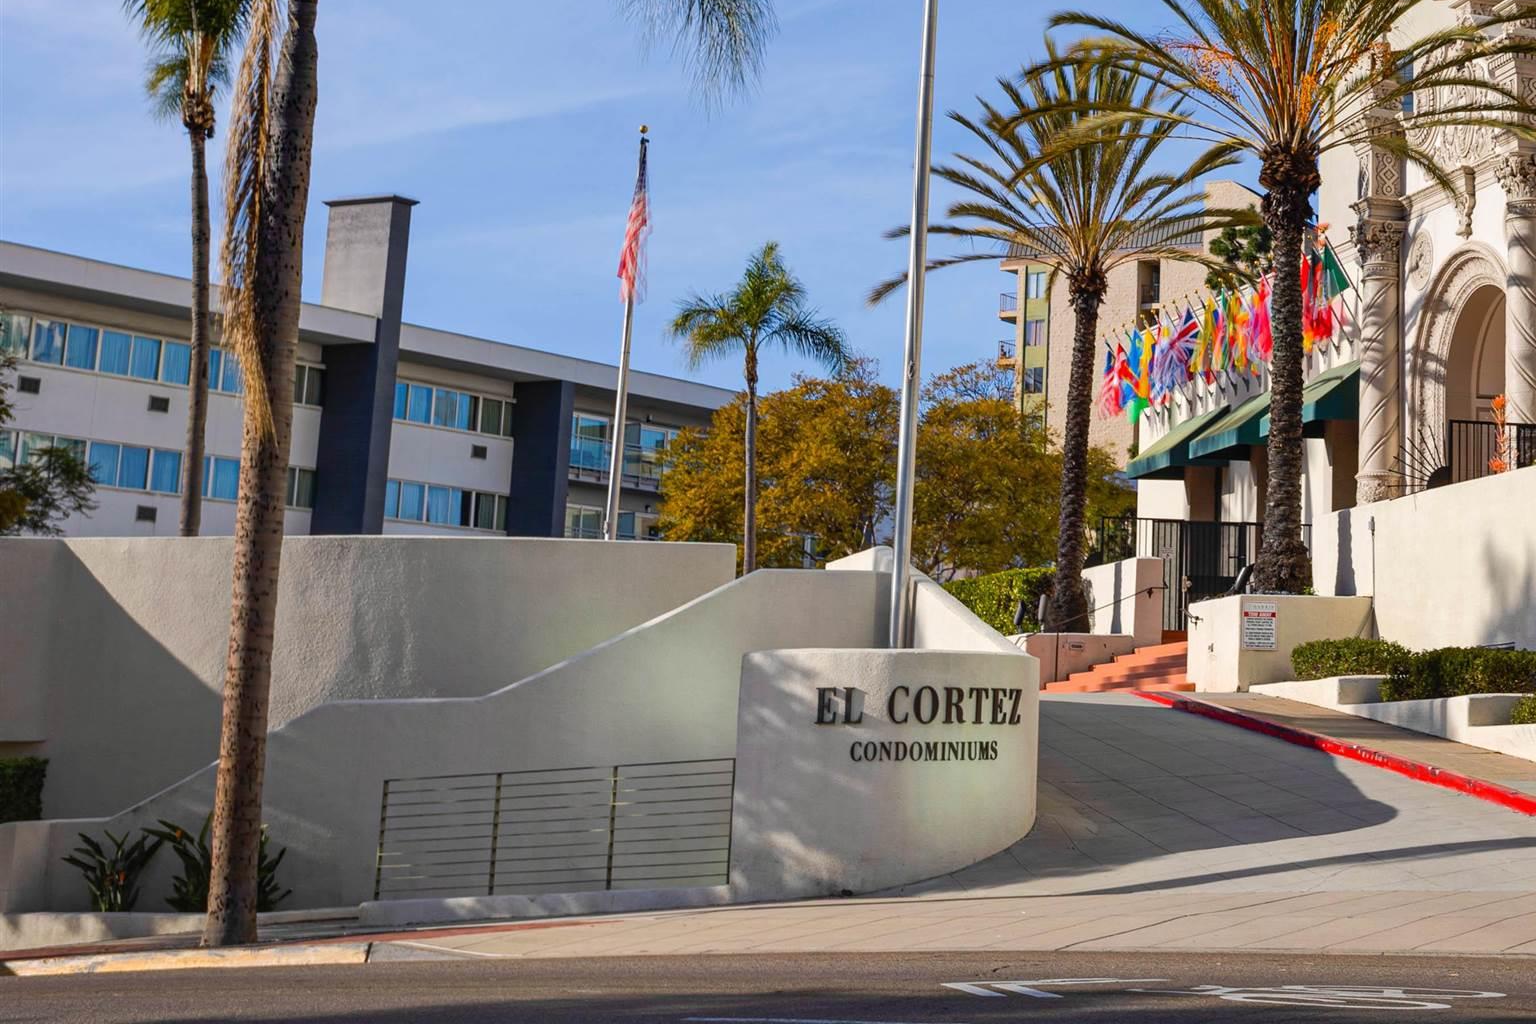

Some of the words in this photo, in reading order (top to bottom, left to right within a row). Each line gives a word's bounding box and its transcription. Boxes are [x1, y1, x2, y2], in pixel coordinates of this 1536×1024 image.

[814, 686, 864, 725] EL
[887, 685, 1023, 725] CORTEZ
[850, 740, 998, 763] CONDOMINIUMS
